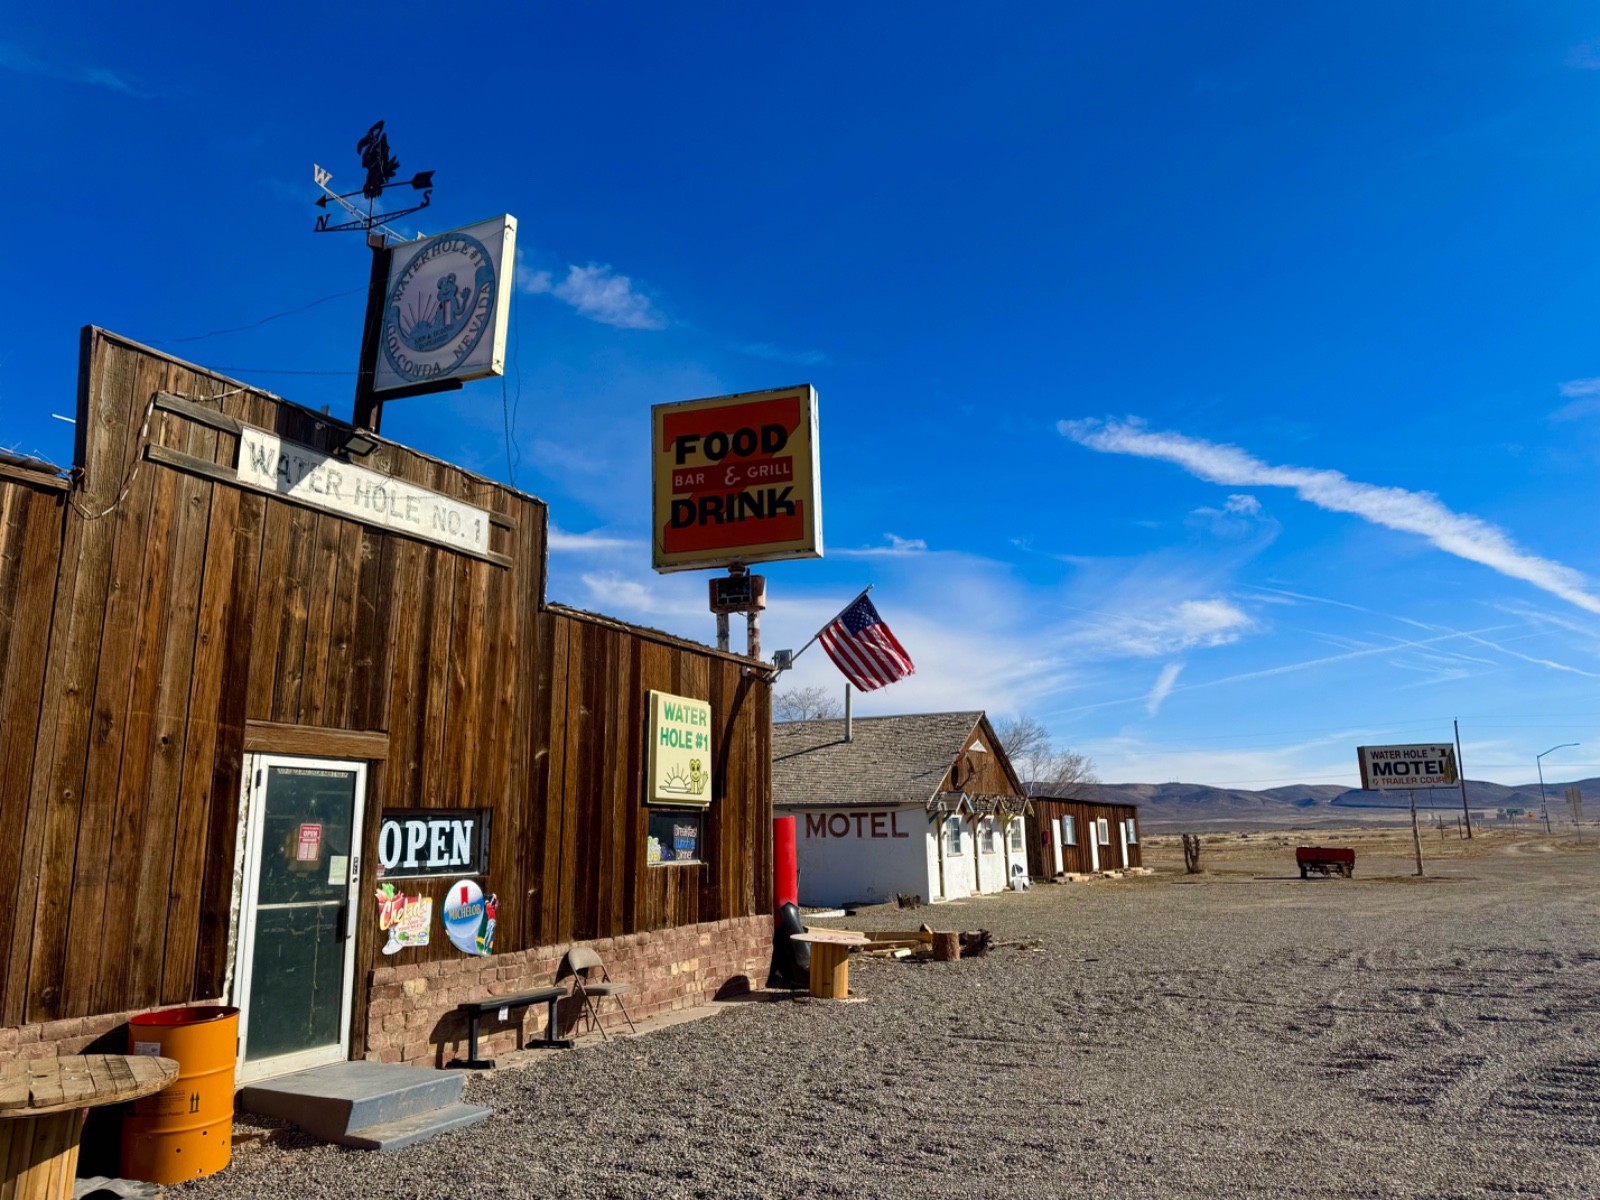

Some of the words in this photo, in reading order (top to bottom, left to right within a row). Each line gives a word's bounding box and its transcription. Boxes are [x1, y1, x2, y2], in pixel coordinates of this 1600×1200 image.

[313, 163, 333, 187] W
[419, 189, 433, 207] S
[314, 213, 331, 232] N
[387, 323, 442, 377] GOLCONDA
[453, 282, 491, 359] NEVADA
[675, 423, 789, 465] FOOD
[674, 472, 706, 487] BAR
[724, 466, 741, 486] &
[747, 463, 791, 479] GRILL
[248, 441, 343, 501] WATER
[353, 477, 421, 525] HOLE
[432, 504, 465, 538] NO.
[473, 518, 482, 544] 1
[671, 485, 797, 529] DRINK
[663, 700, 708, 727] WATER
[659, 726, 693, 751] HOLE
[695, 733, 709, 753] #1
[1371, 750, 1401, 760] WATER
[1404, 749, 1428, 758] HOLE
[1382, 776, 1418, 785] TRAILER
[303, 830, 318, 838] OPEN
[806, 812, 909, 838] MOTEL
[378, 820, 474, 869] OPEN
[379, 893, 428, 931] Chelada
[448, 903, 482, 921] MICHELOB
